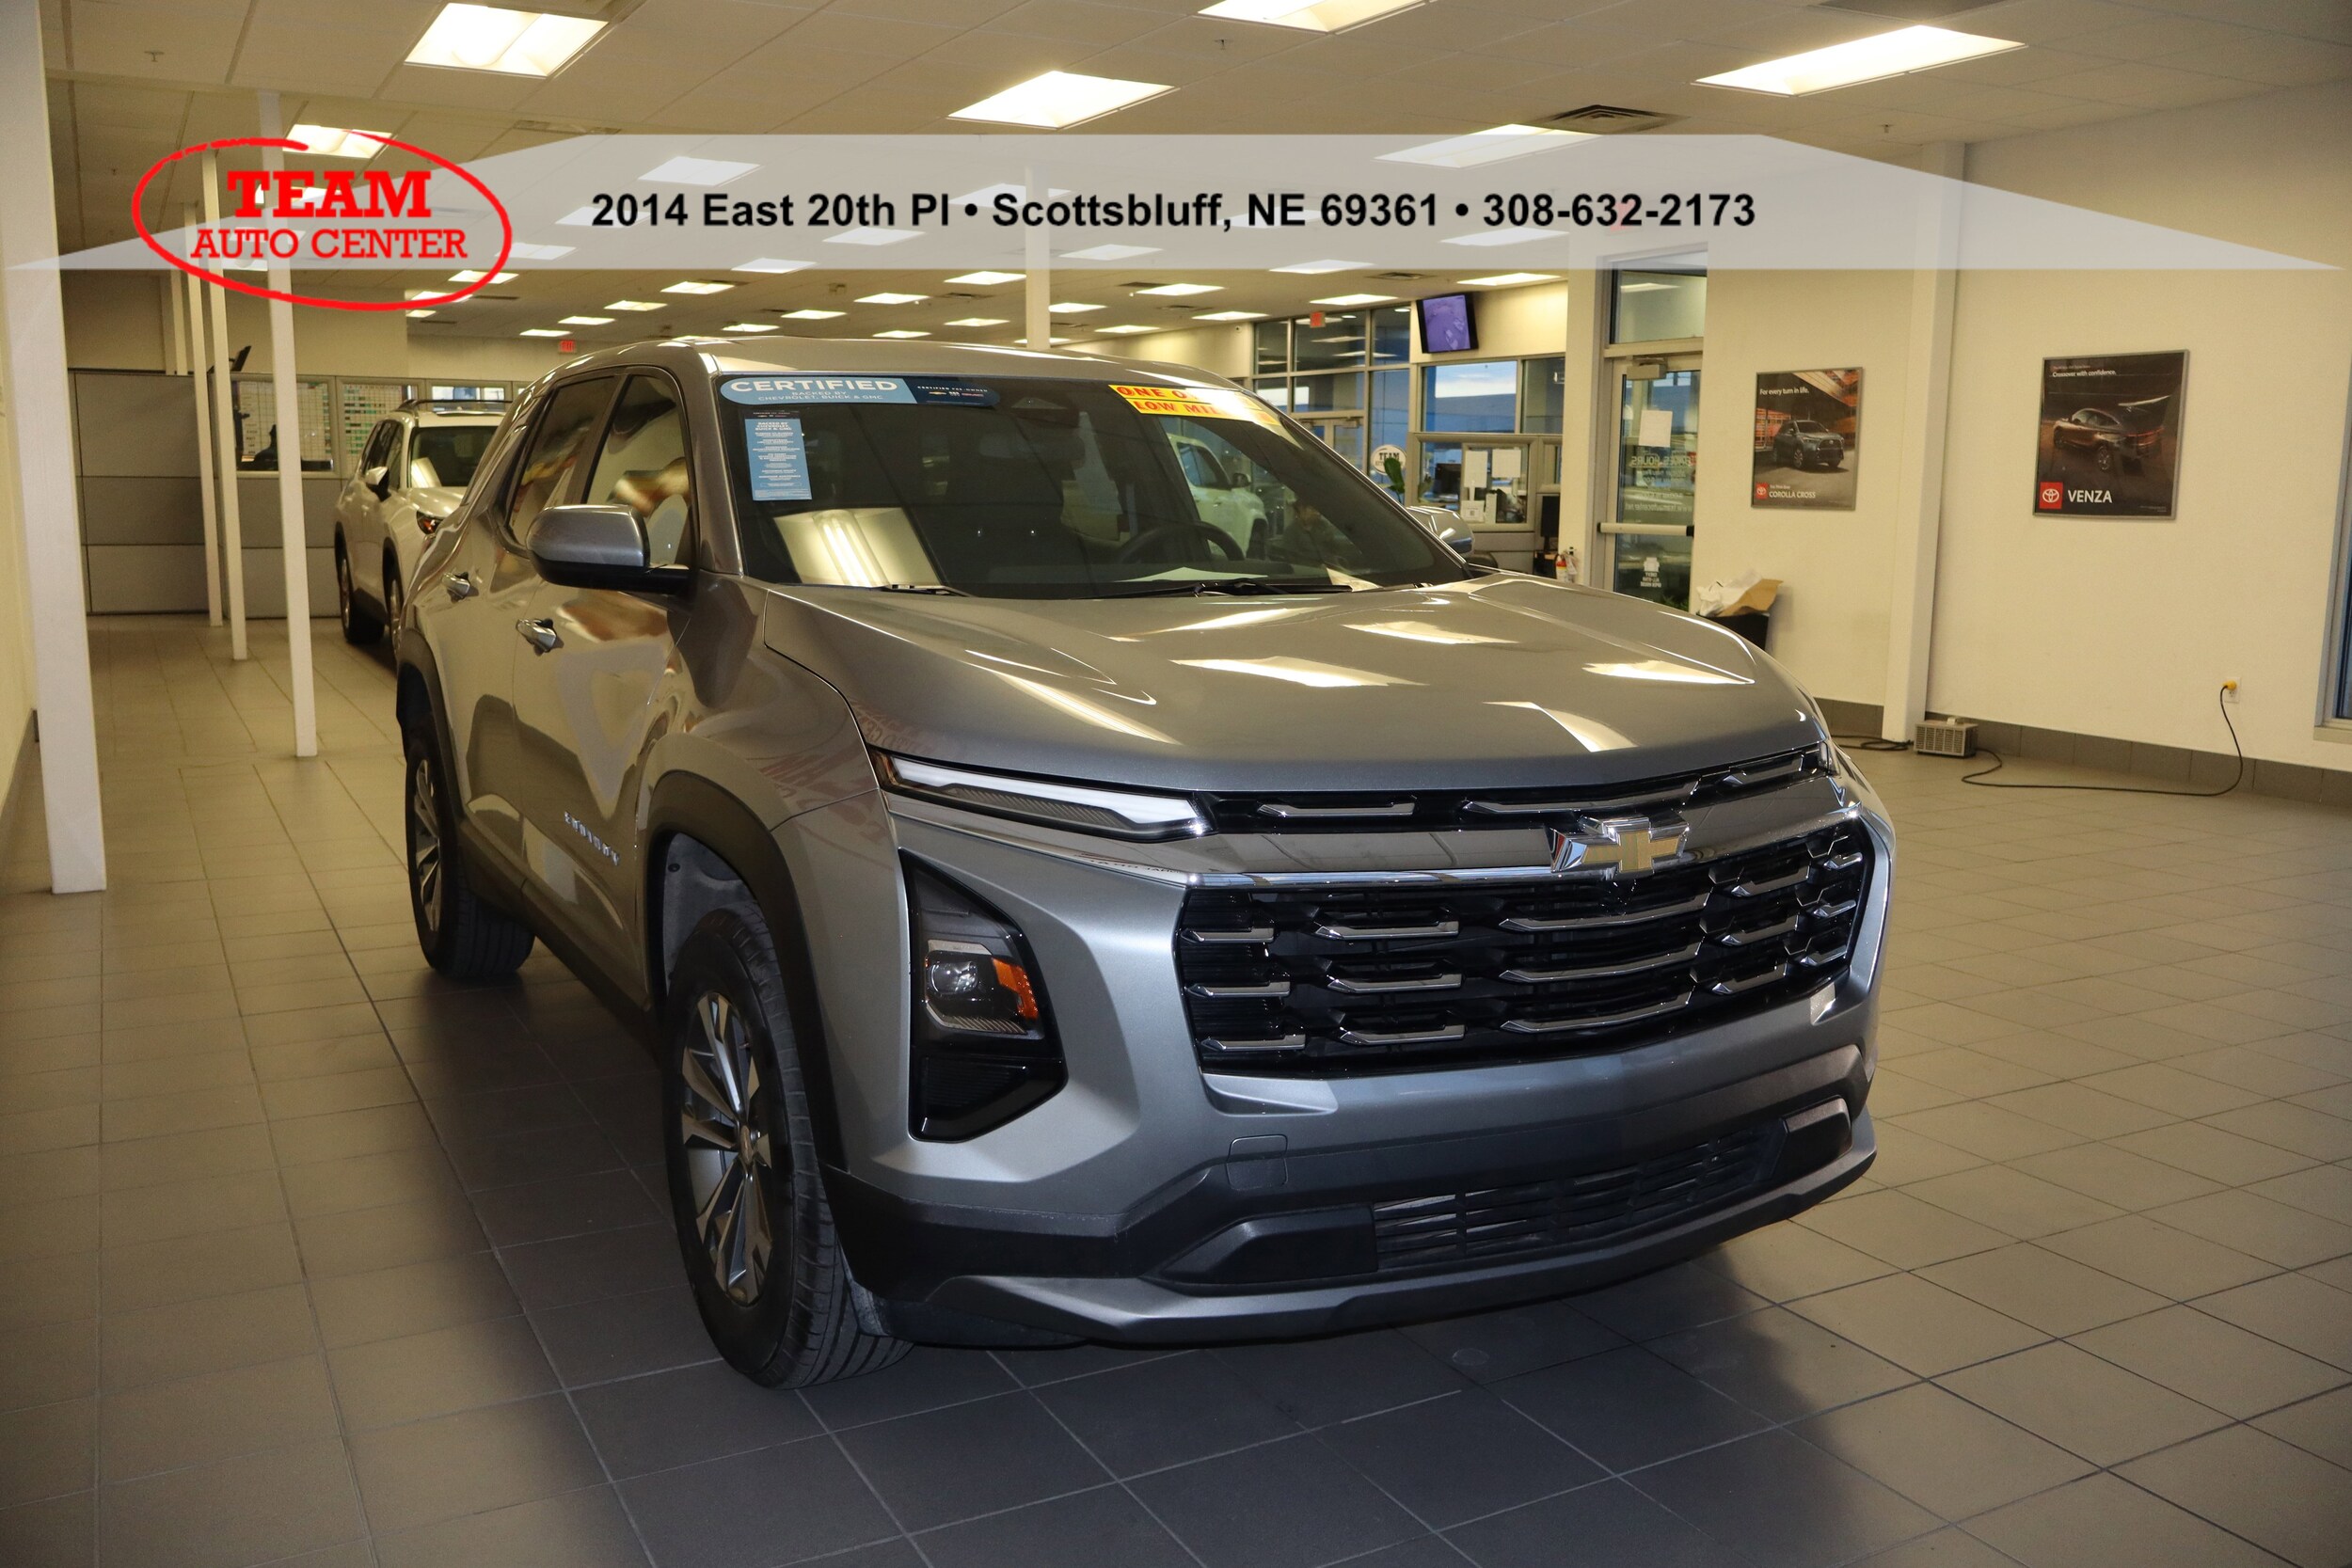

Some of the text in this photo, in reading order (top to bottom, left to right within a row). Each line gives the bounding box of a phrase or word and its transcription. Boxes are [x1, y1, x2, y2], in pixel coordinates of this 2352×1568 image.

[730, 380, 898, 391] CERTIFIED
[1117, 386, 1168, 397] ONE
[1133, 401, 1175, 411] LOW
[1769, 490, 1796, 499] COROLLA
[2068, 489, 2113, 503] VENZA
